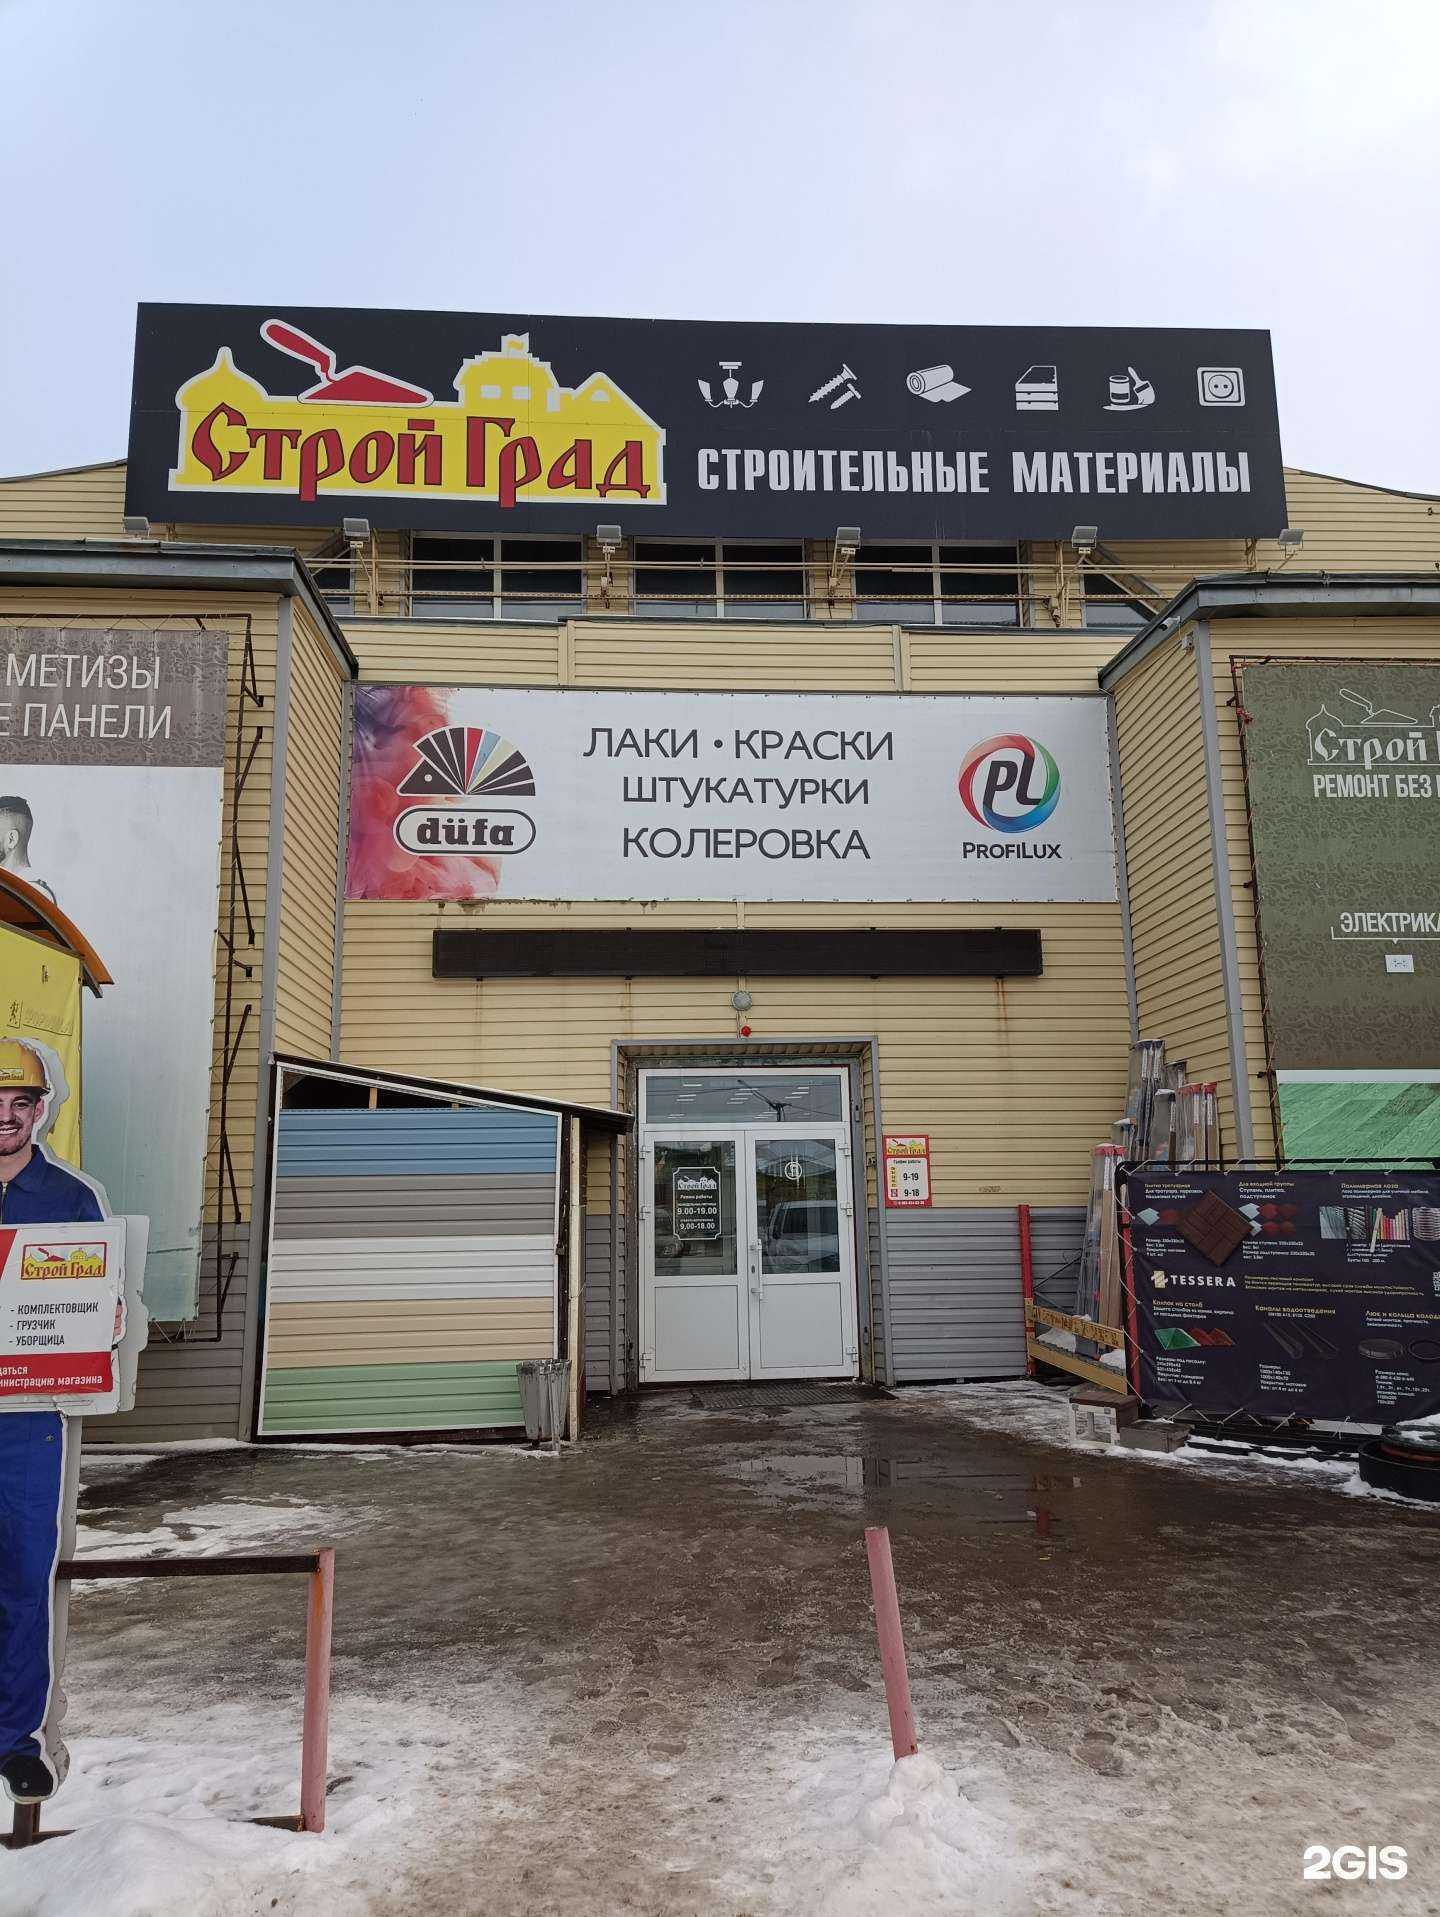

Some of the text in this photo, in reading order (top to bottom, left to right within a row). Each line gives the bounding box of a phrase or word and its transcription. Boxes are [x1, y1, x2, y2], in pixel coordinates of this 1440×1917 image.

[698, 447, 1252, 494] СТРОИТЕЛЬНЫЕ МАТЕРИАЛЫ
[6, 653, 161, 690] МЕТИЗЫ
[23, 703, 172, 739] ПАНЕЛИ
[582, 727, 894, 761] ЛАКИ КРАСКИ
[623, 776, 870, 809] ШТУКАТУРКИ
[1312, 773, 1390, 798] РЕМОНТ
[1396, 774, 1432, 798] БЕЗ
[416, 817, 515, 847] düfa
[622, 827, 871, 860] КОЛЕРОВКА
[1339, 911, 1440, 934] ЭЛЕКТРИК
[903, 1172, 919, 1181] 9-19
[904, 1188, 920, 1197] 9-18
[1170, 1274, 1236, 1287] TESSERA
[17, 1302, 99, 1316] КОМПЛЕКТОВЩИК
[16, 1319, 56, 1331] ГРУЗЧИК
[16, 1334, 65, 1347] УБОРЩИЦА
[57, 1375, 103, 1386] магазина
